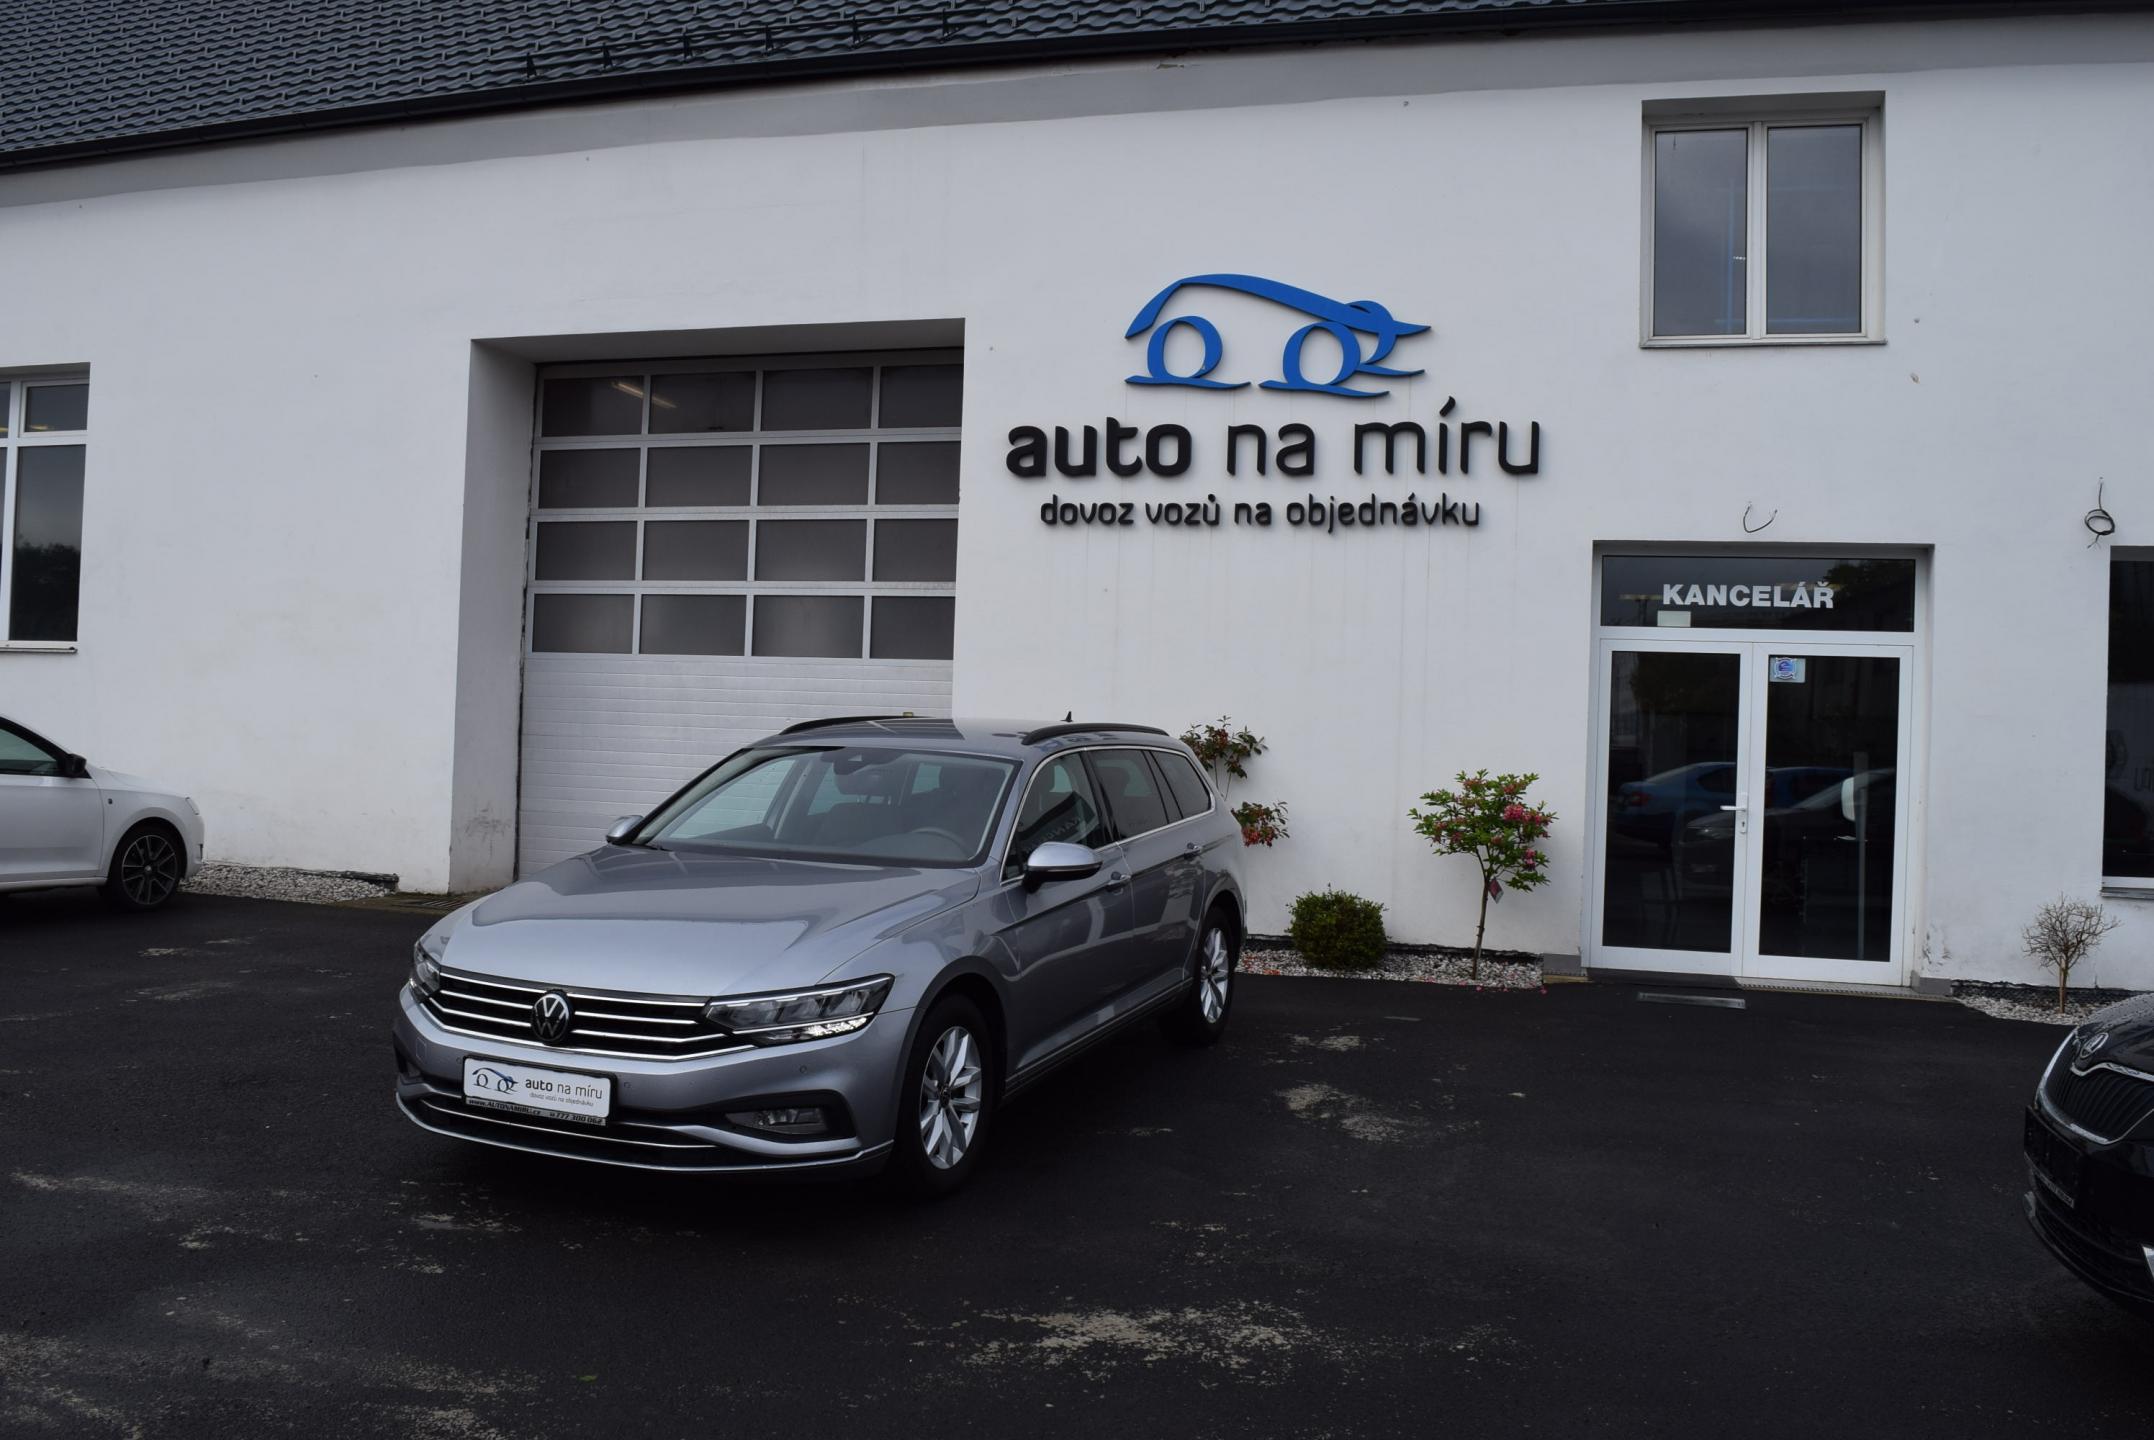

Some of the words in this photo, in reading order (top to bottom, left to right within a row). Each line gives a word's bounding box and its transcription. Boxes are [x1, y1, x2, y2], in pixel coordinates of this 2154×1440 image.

[1006, 417, 1193, 477] auto
[1227, 422, 1315, 476] na
[1353, 396, 1540, 476] míru
[1040, 494, 1134, 525] dovoz
[1145, 493, 1220, 525] vozů
[1234, 502, 1272, 525] na
[1286, 493, 1480, 533] objednávku
[1663, 581, 1834, 609] KANCELÁŘ
[525, 1078, 553, 1092] auto
[557, 1083, 571, 1095] na
[575, 1084, 603, 1099] míru
